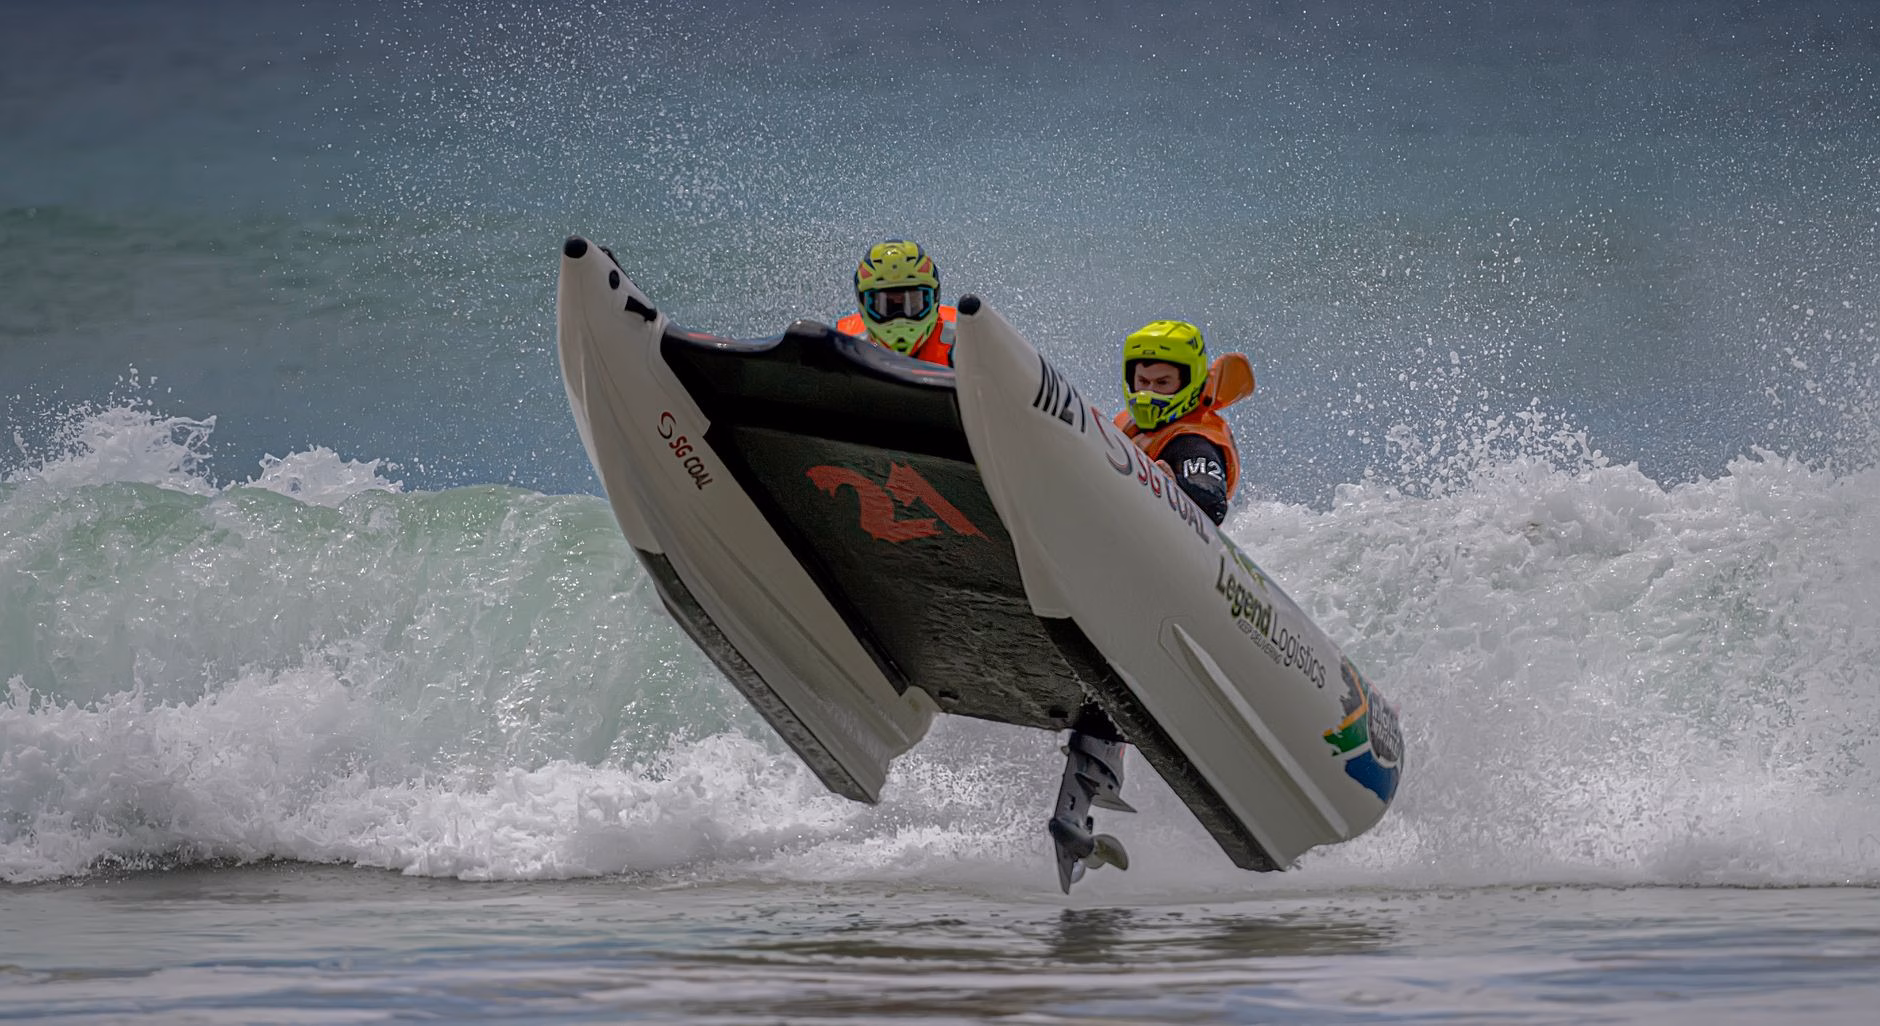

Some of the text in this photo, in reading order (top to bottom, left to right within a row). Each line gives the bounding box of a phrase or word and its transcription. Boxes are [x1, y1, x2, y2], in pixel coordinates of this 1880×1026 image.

[1033, 354, 1086, 434] M21
[668, 435, 693, 458] SG
[683, 456, 713, 490] COAL
[805, 460, 994, 543] 21
[1215, 555, 1327, 689] Legend Logistics
